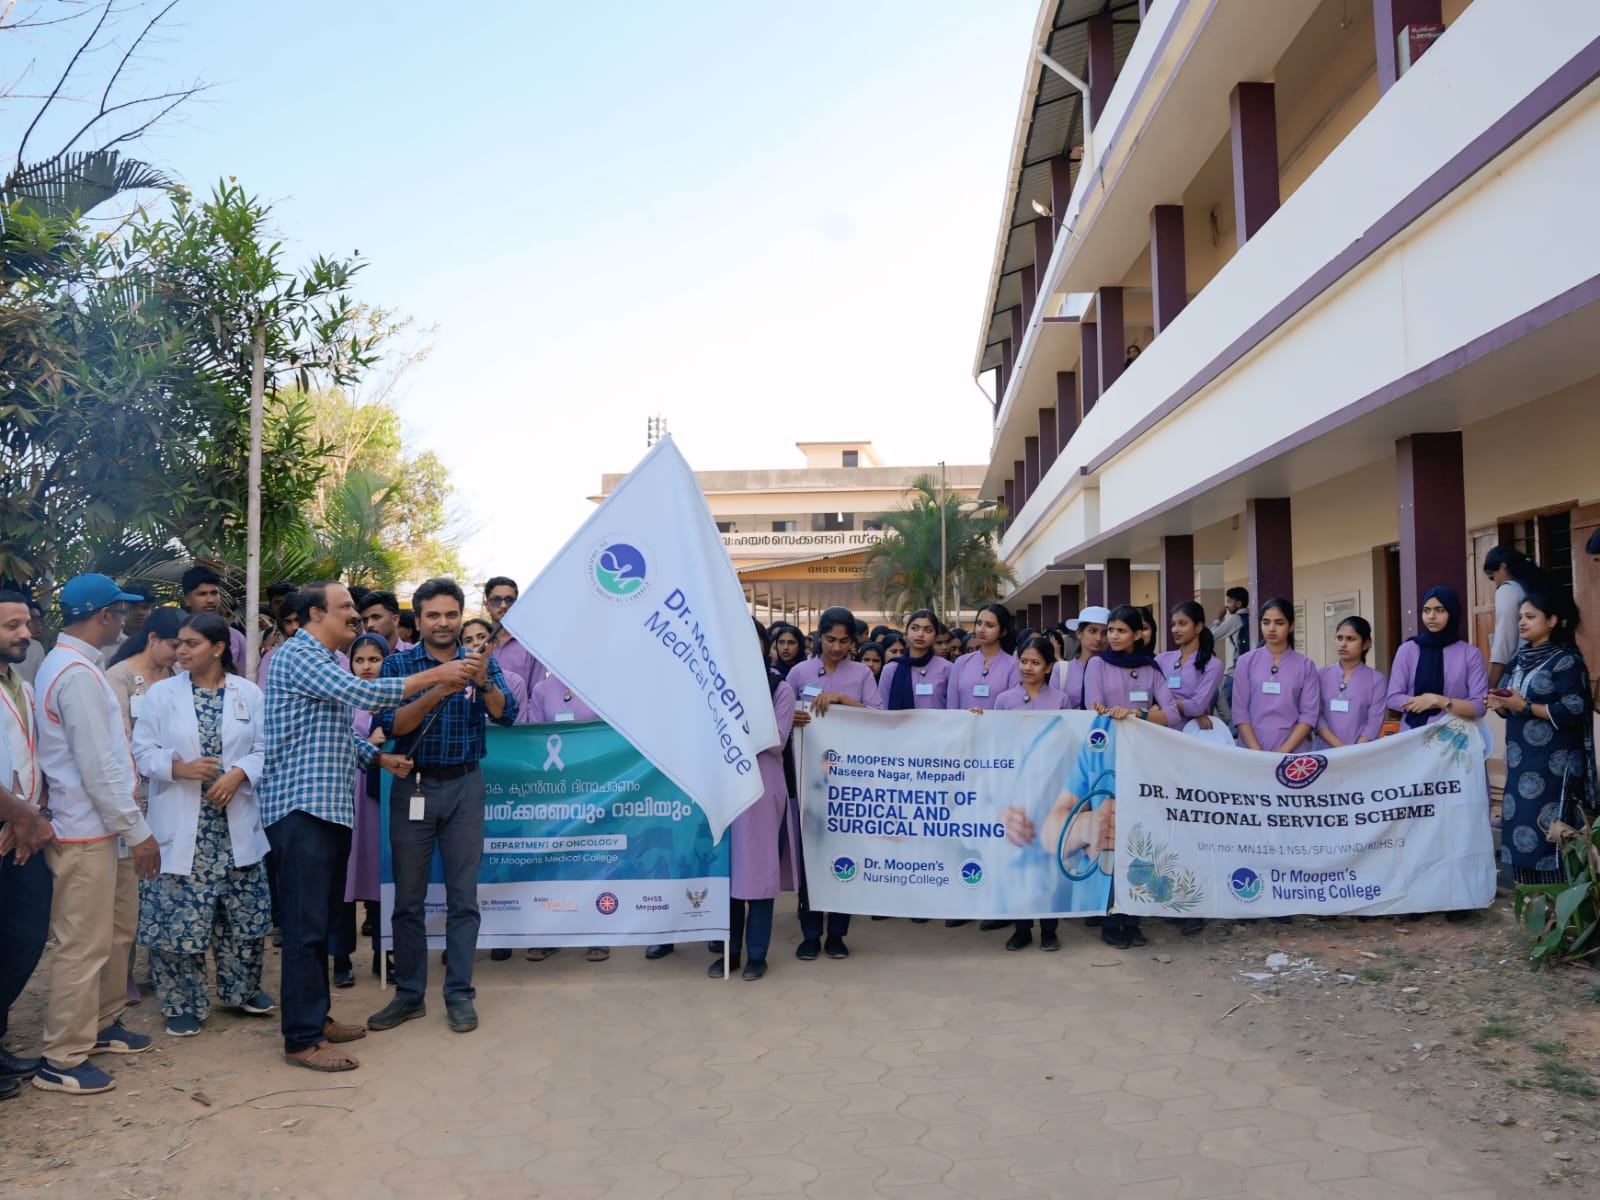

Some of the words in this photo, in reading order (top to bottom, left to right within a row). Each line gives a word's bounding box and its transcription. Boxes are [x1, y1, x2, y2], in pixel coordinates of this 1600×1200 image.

[664, 588, 691, 625] Dr.
[644, 610, 709, 691] Medical
[707, 690, 752, 776] College
[829, 753, 843, 763] Dr.
[847, 754, 905, 767] MOOPEN'S
[908, 758, 960, 769] NURSING
[964, 759, 1015, 769] COLLEGE
[829, 766, 875, 778] Naseera
[878, 769, 913, 782] Nagar,
[917, 770, 965, 782] Meppadi
[828, 786, 949, 805] DEPARTMENT
[954, 791, 977, 805] OF
[1139, 784, 1168, 799] DR.
[1176, 788, 1272, 807] MOOPEN'S
[1277, 791, 1364, 808] NURSING
[1371, 781, 1462, 801] COLLEGE
[828, 802, 908, 819] MEDICAL
[913, 806, 950, 820] AND
[1166, 808, 1261, 826] NATIONAL
[1267, 811, 1349, 827] SERVICE
[1354, 804, 1435, 825] SCHEME
[827, 818, 917, 836] SURGICAL
[923, 822, 1005, 838] NURSING
[490, 841, 549, 850] DEPARTMENT
[566, 839, 618, 847] ONCOLOGY
[545, 855, 581, 864] Medical
[583, 853, 618, 864] College
[864, 858, 880, 869] Dr.
[884, 859, 944, 873] Moopen's
[863, 872, 907, 885] Nursing
[908, 874, 949, 887] College
[1271, 869, 1286, 882] Dr
[1290, 868, 1357, 886] Moopen's
[1272, 886, 1327, 901] Nursing
[1328, 884, 1381, 900] College
